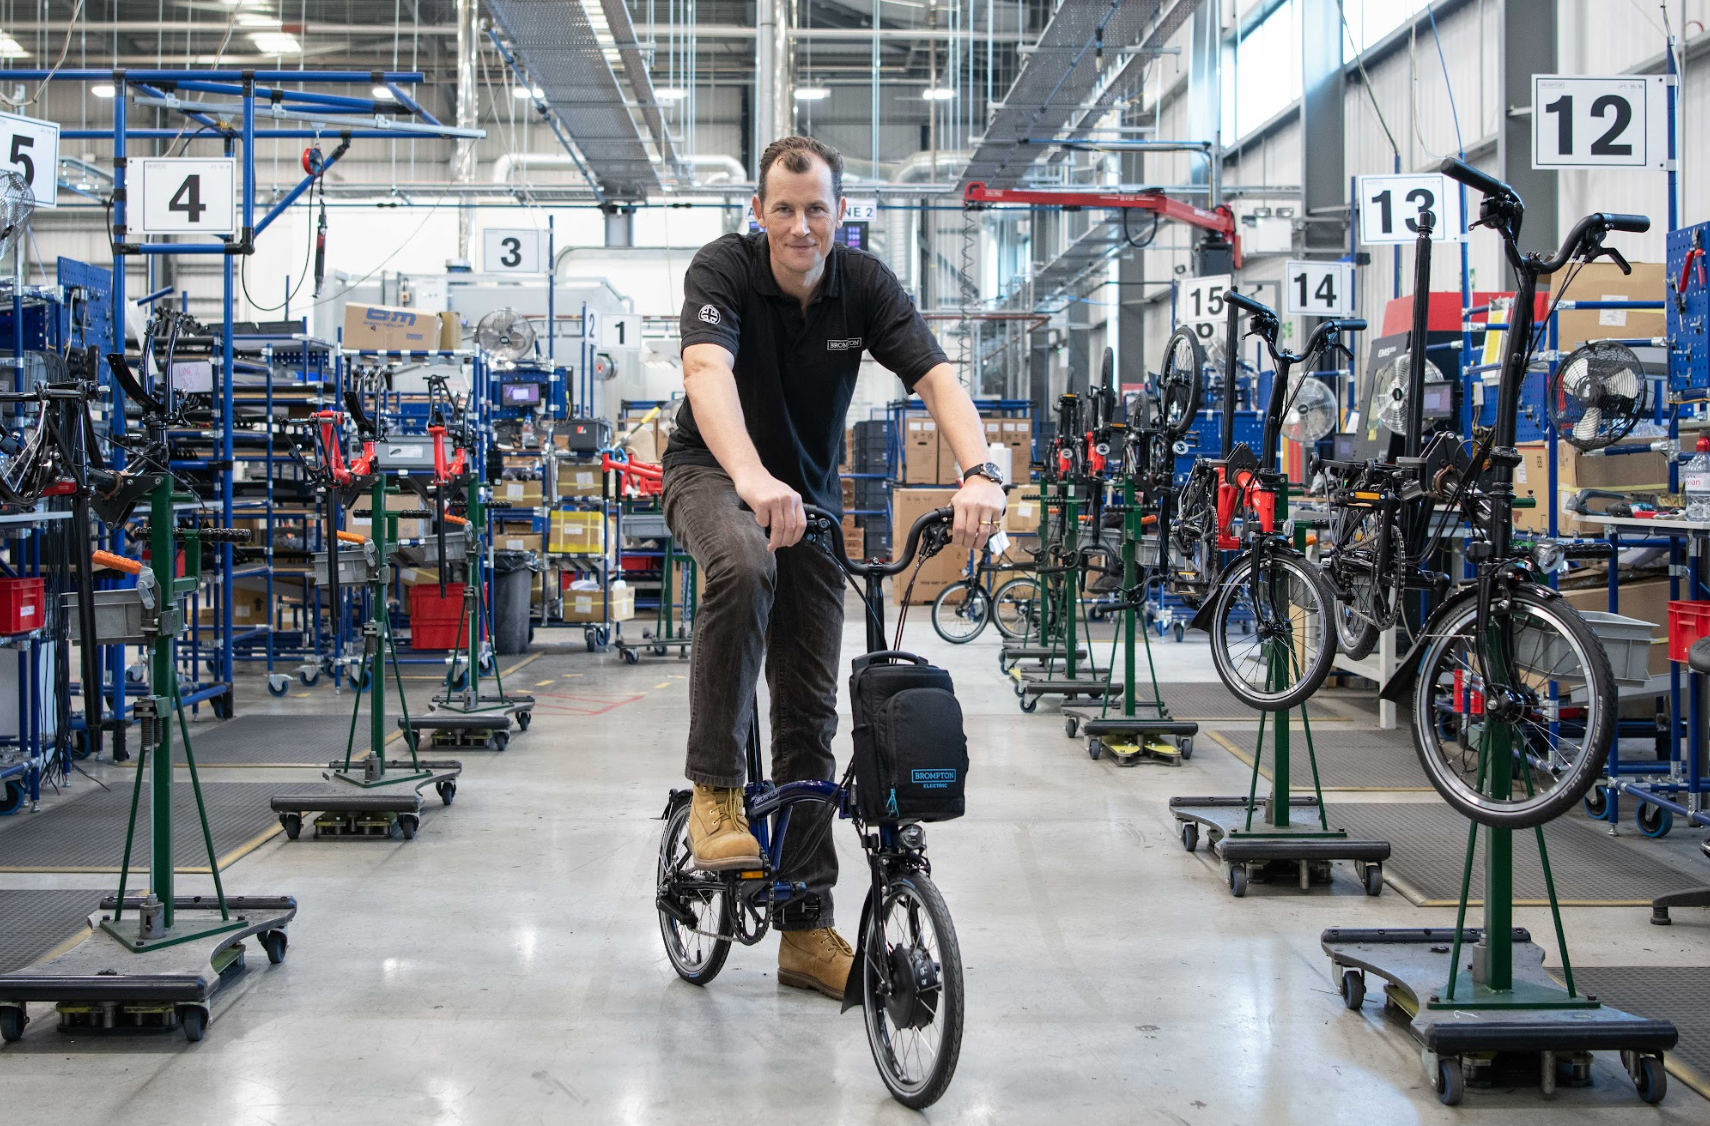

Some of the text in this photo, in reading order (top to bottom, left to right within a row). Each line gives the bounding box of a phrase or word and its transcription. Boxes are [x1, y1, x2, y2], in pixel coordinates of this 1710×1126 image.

[1545, 94, 1633, 156] 12
[9, 133, 35, 189] 5
[168, 174, 207, 223] 4
[844, 207, 873, 217] NE 2
[1371, 188, 1437, 234] 13
[500, 237, 522, 268] 3
[1190, 286, 1224, 317] 15
[1293, 272, 1338, 308] 14
[588, 313, 595, 338] 2
[614, 321, 625, 345] 1
[1686, 478, 1701, 486] vian
[915, 771, 955, 780] BROMPTON
